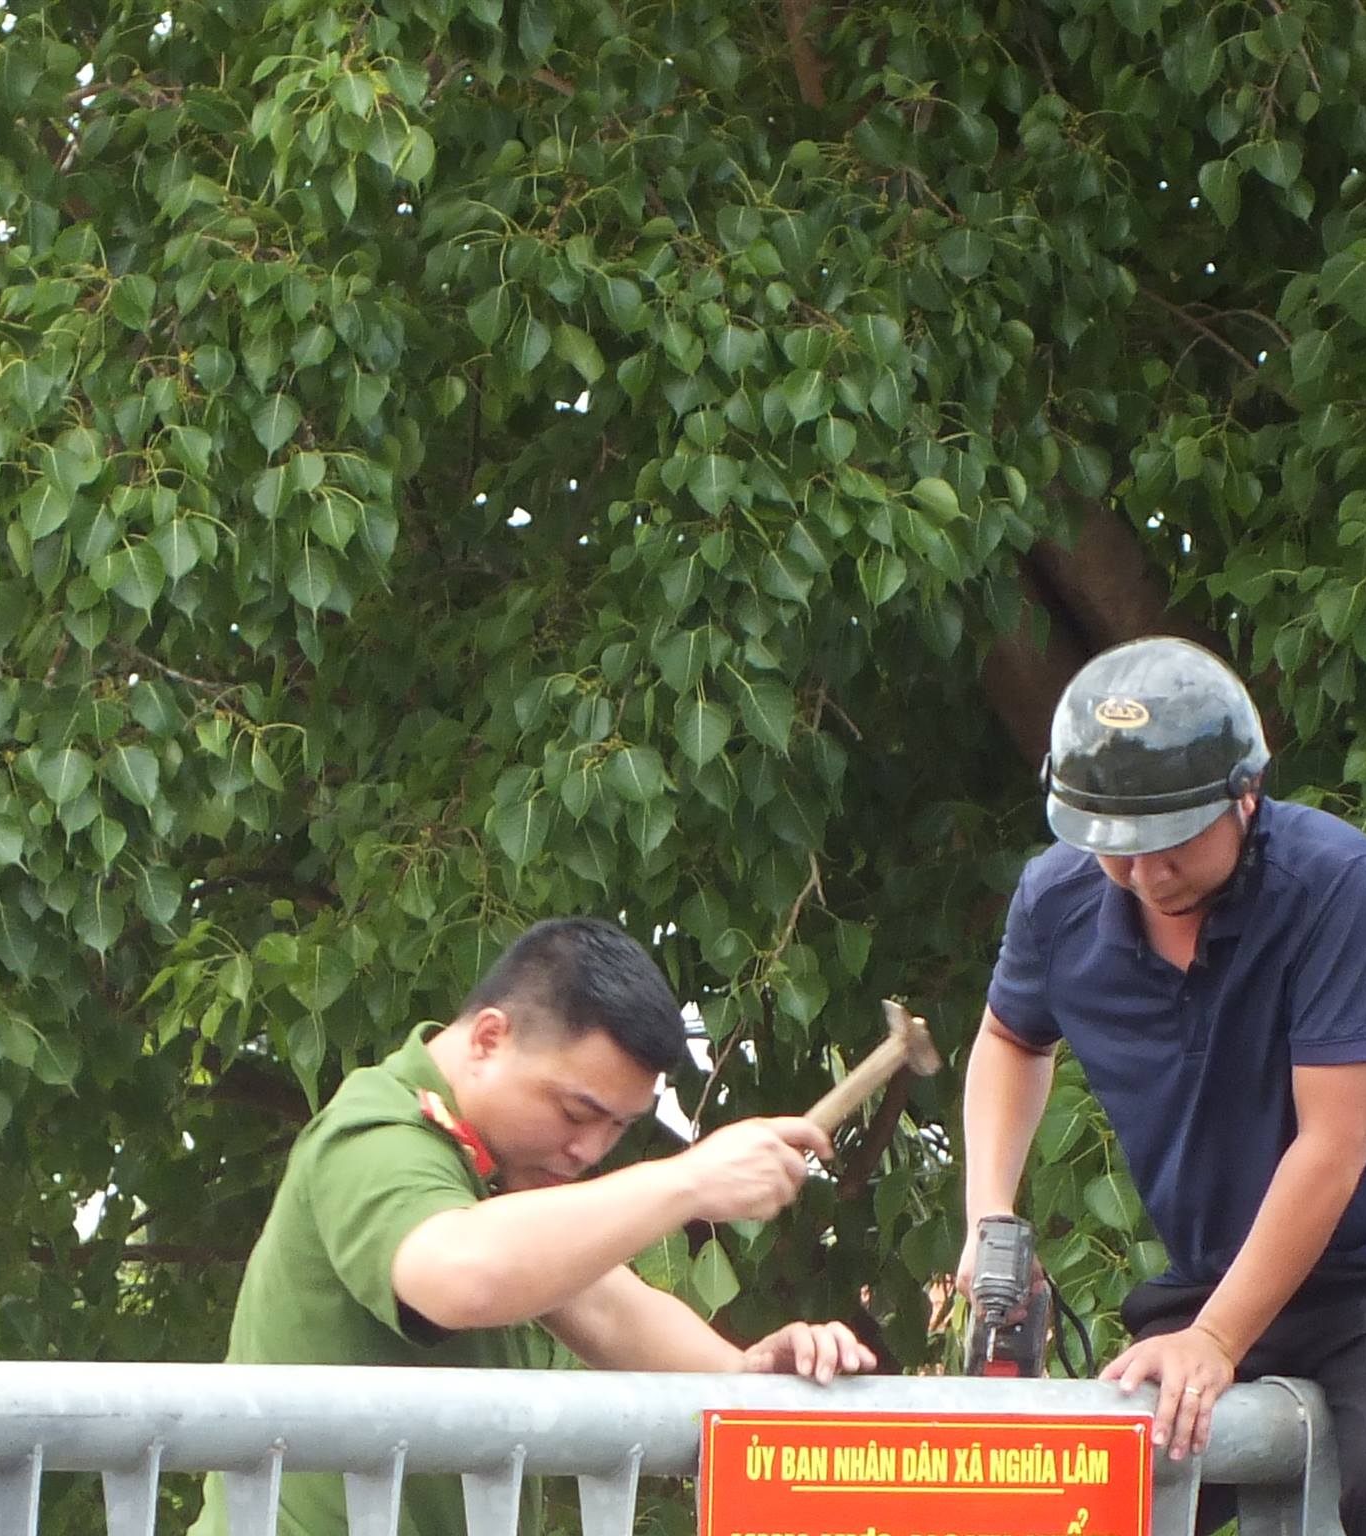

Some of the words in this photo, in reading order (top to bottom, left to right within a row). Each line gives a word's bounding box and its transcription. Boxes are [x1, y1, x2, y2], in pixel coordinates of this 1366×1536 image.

[748, 1436, 774, 1479] ỦY
[782, 1447, 827, 1480] BAN
[835, 1441, 895, 1481] NHÂN
[903, 1442, 947, 1481] DÂN
[955, 1443, 983, 1482] XÃ
[990, 1444, 1055, 1482] NGHĨA
[1063, 1444, 1107, 1483] LÂM
